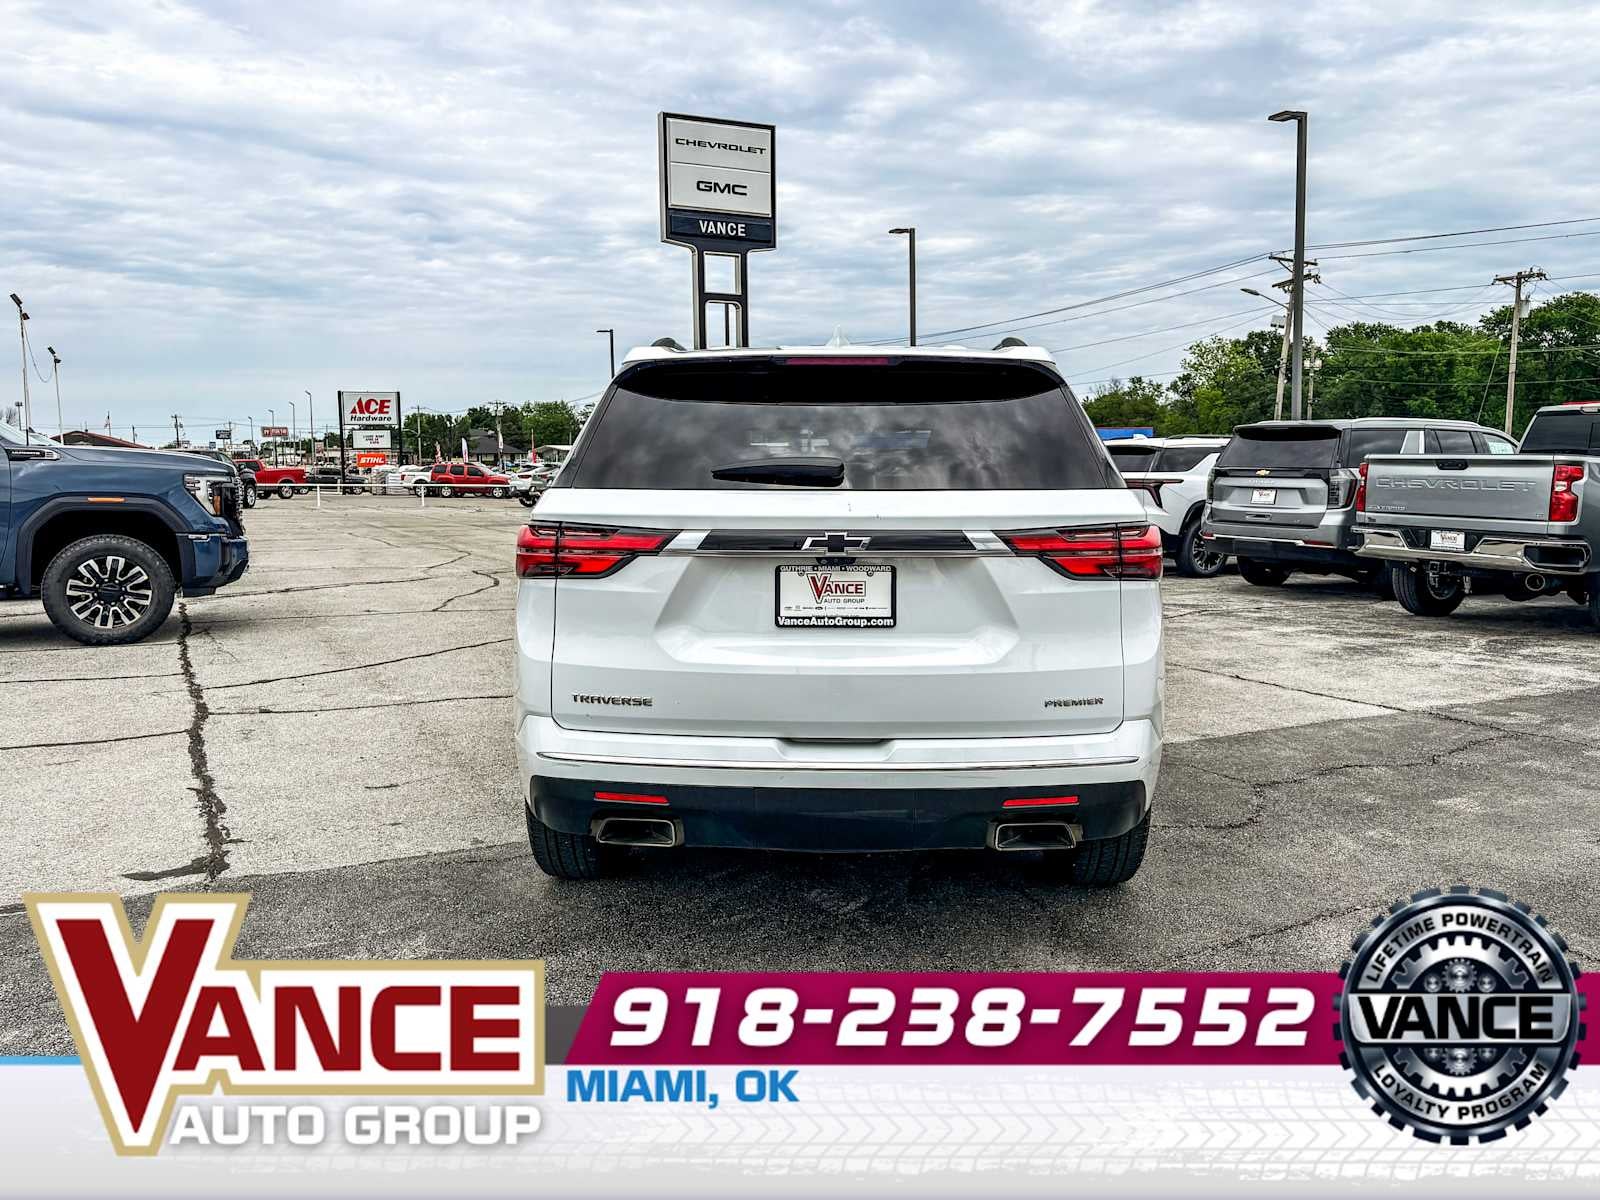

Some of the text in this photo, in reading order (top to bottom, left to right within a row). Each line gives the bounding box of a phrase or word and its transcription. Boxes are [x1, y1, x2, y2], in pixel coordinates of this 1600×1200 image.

[675, 138, 766, 154] CHEVROLET
[696, 180, 748, 196] GMC
[699, 219, 746, 237] VANCE
[350, 397, 391, 415] ACE
[1376, 477, 1536, 491] CHEVROLET
[809, 575, 864, 600] VANCE
[778, 617, 893, 627] VanceAutoGroup.com
[572, 694, 653, 707] TRAVERSE
[1044, 697, 1104, 708] PREMIER
